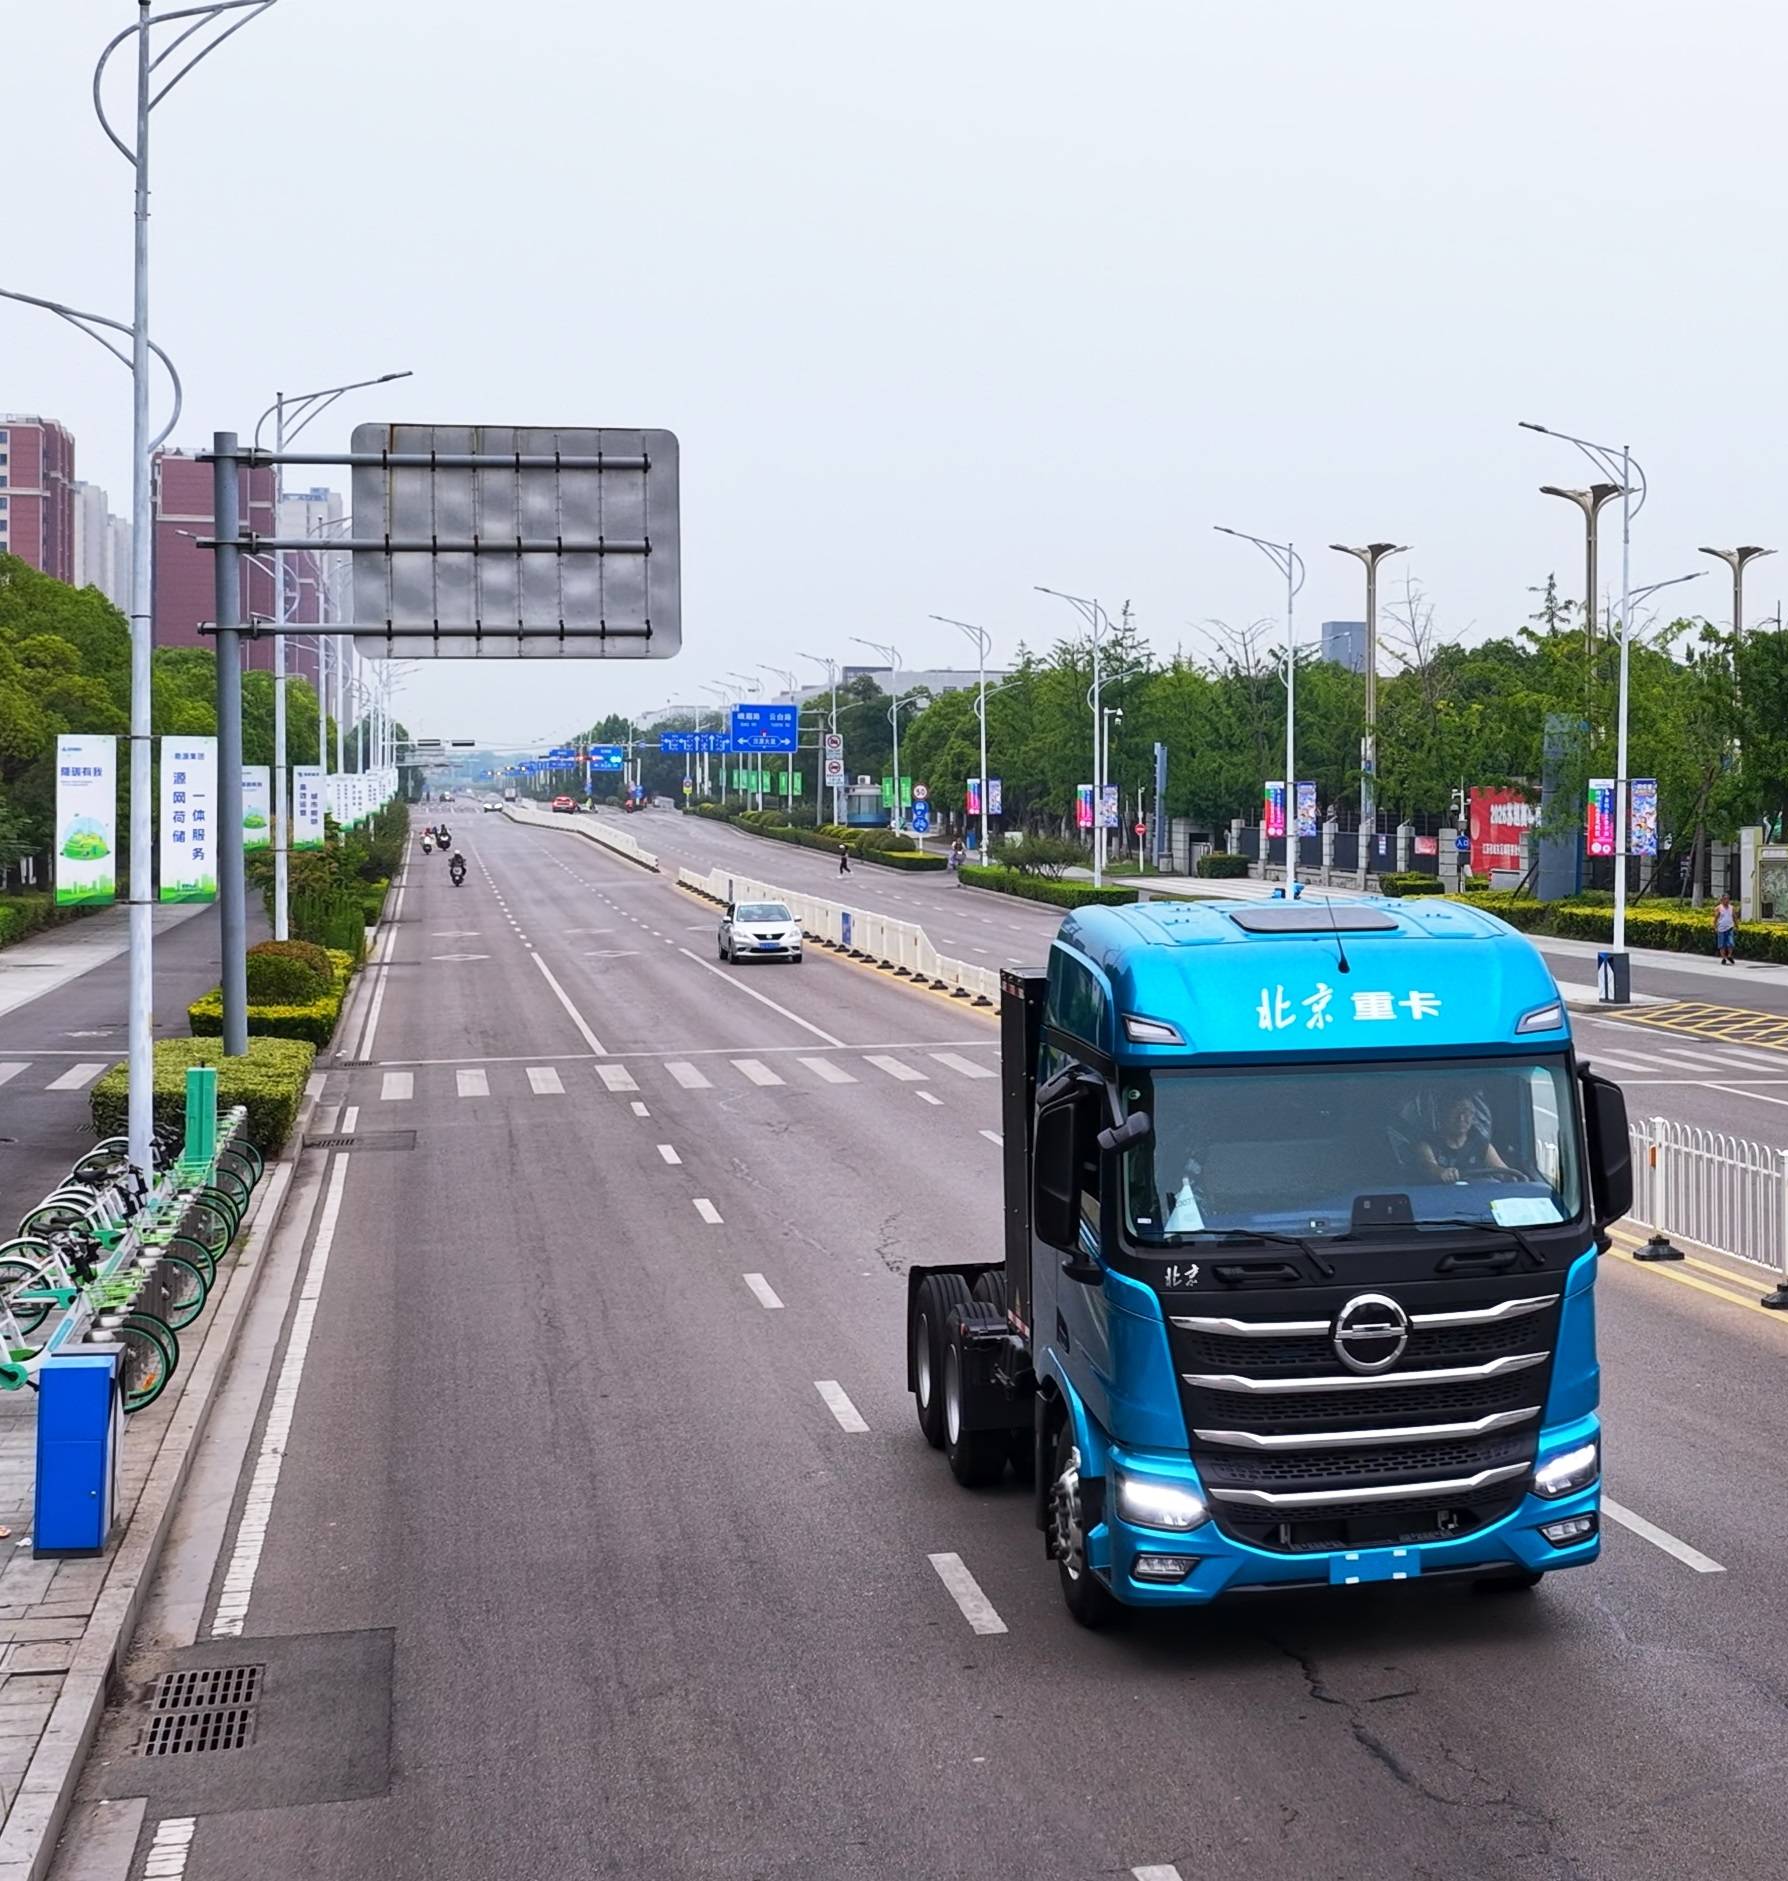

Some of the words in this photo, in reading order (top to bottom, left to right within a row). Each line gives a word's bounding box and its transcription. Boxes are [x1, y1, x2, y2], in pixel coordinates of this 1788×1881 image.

[173, 772, 186, 843] 源网荷储
[192, 793, 205, 861] 一体服务
[1164, 1264, 1200, 1288] 北京
